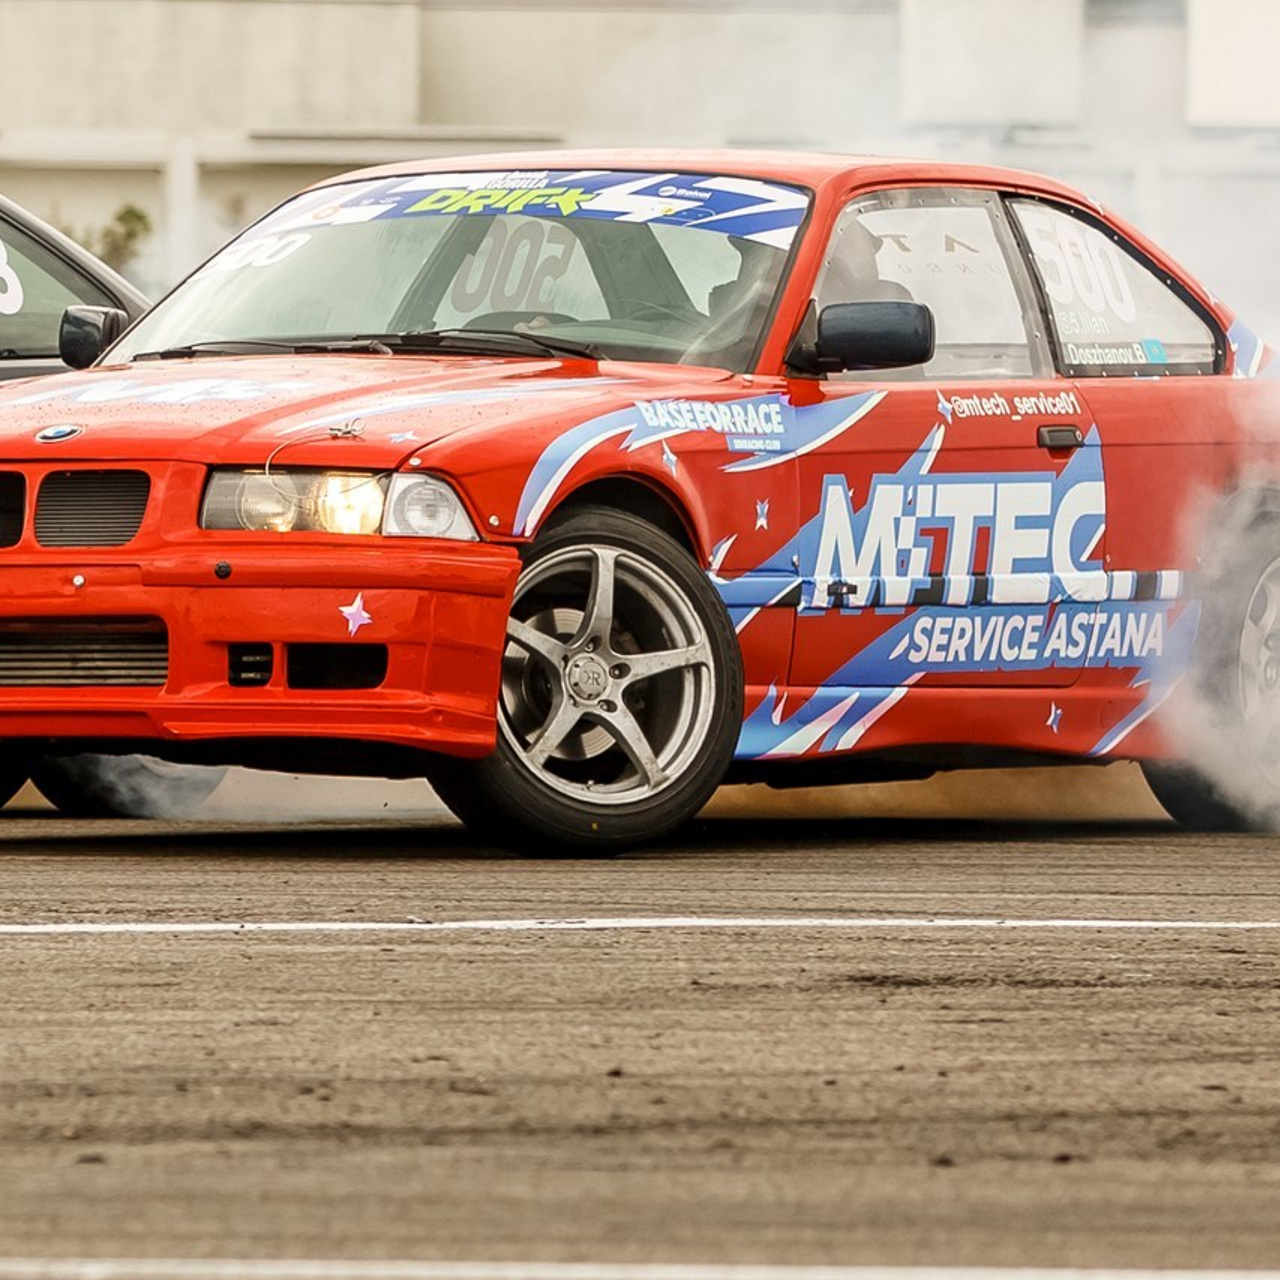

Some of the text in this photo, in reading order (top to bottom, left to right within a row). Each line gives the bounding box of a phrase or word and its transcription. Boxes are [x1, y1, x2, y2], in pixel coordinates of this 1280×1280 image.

[402, 187, 596, 217] DRIFT
[1022, 208, 1136, 324] 500
[950, 391, 1081, 420] @mtech_service01
[907, 612, 1164, 666] SERVICE ASTANA
